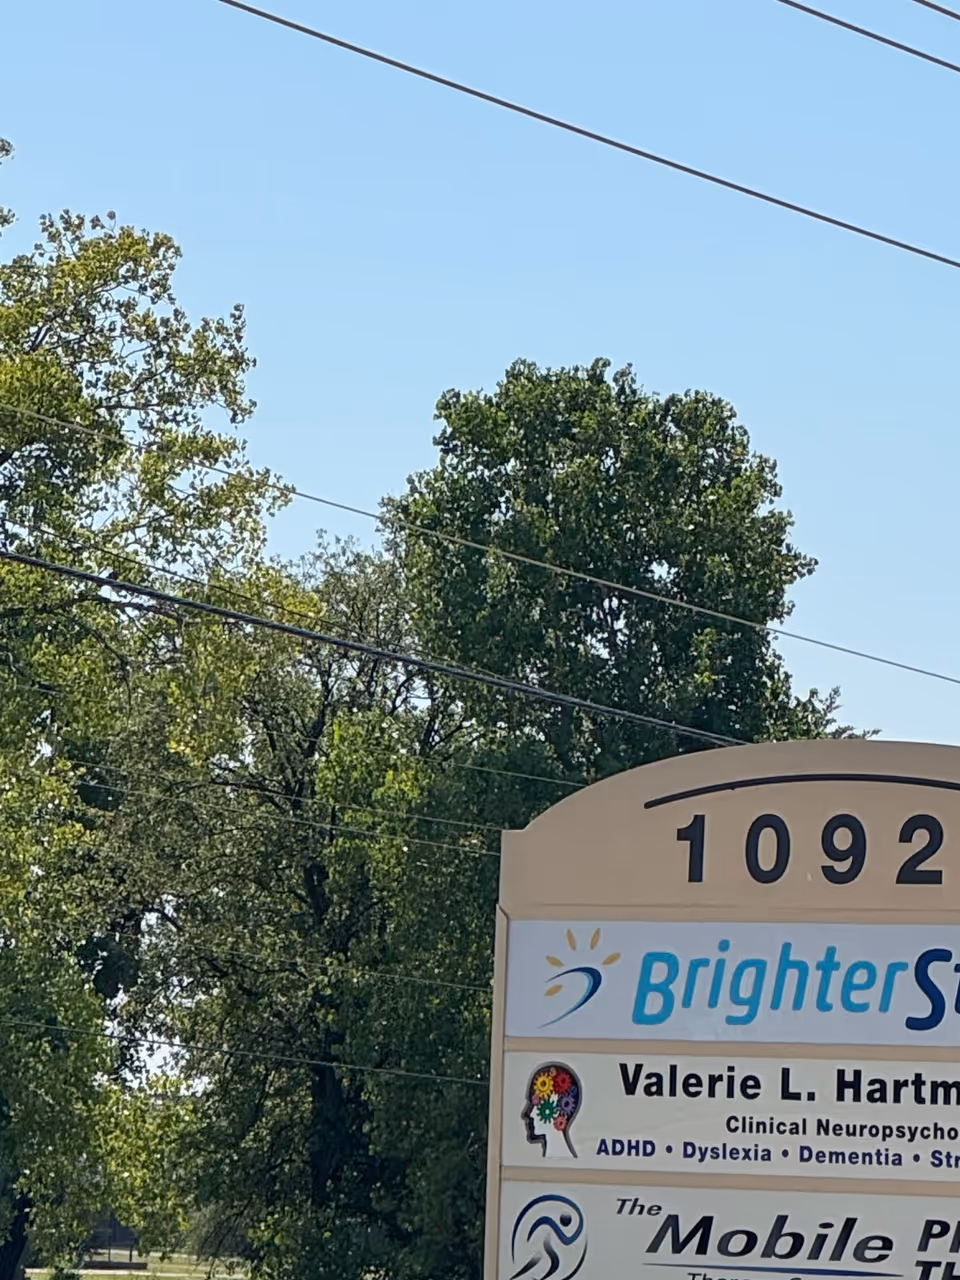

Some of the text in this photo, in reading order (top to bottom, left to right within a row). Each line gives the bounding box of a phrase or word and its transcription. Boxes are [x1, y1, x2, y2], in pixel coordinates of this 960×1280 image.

[619, 1063, 762, 1100] Valerie
[780, 1067, 816, 1102] L.
[725, 1115, 807, 1136] Clinical
[596, 1138, 657, 1157] ADHD
[682, 1141, 772, 1163] Dyslexia
[799, 1145, 903, 1166] Dementia
[615, 1198, 662, 1216] The
[645, 1213, 894, 1264] Mobile
